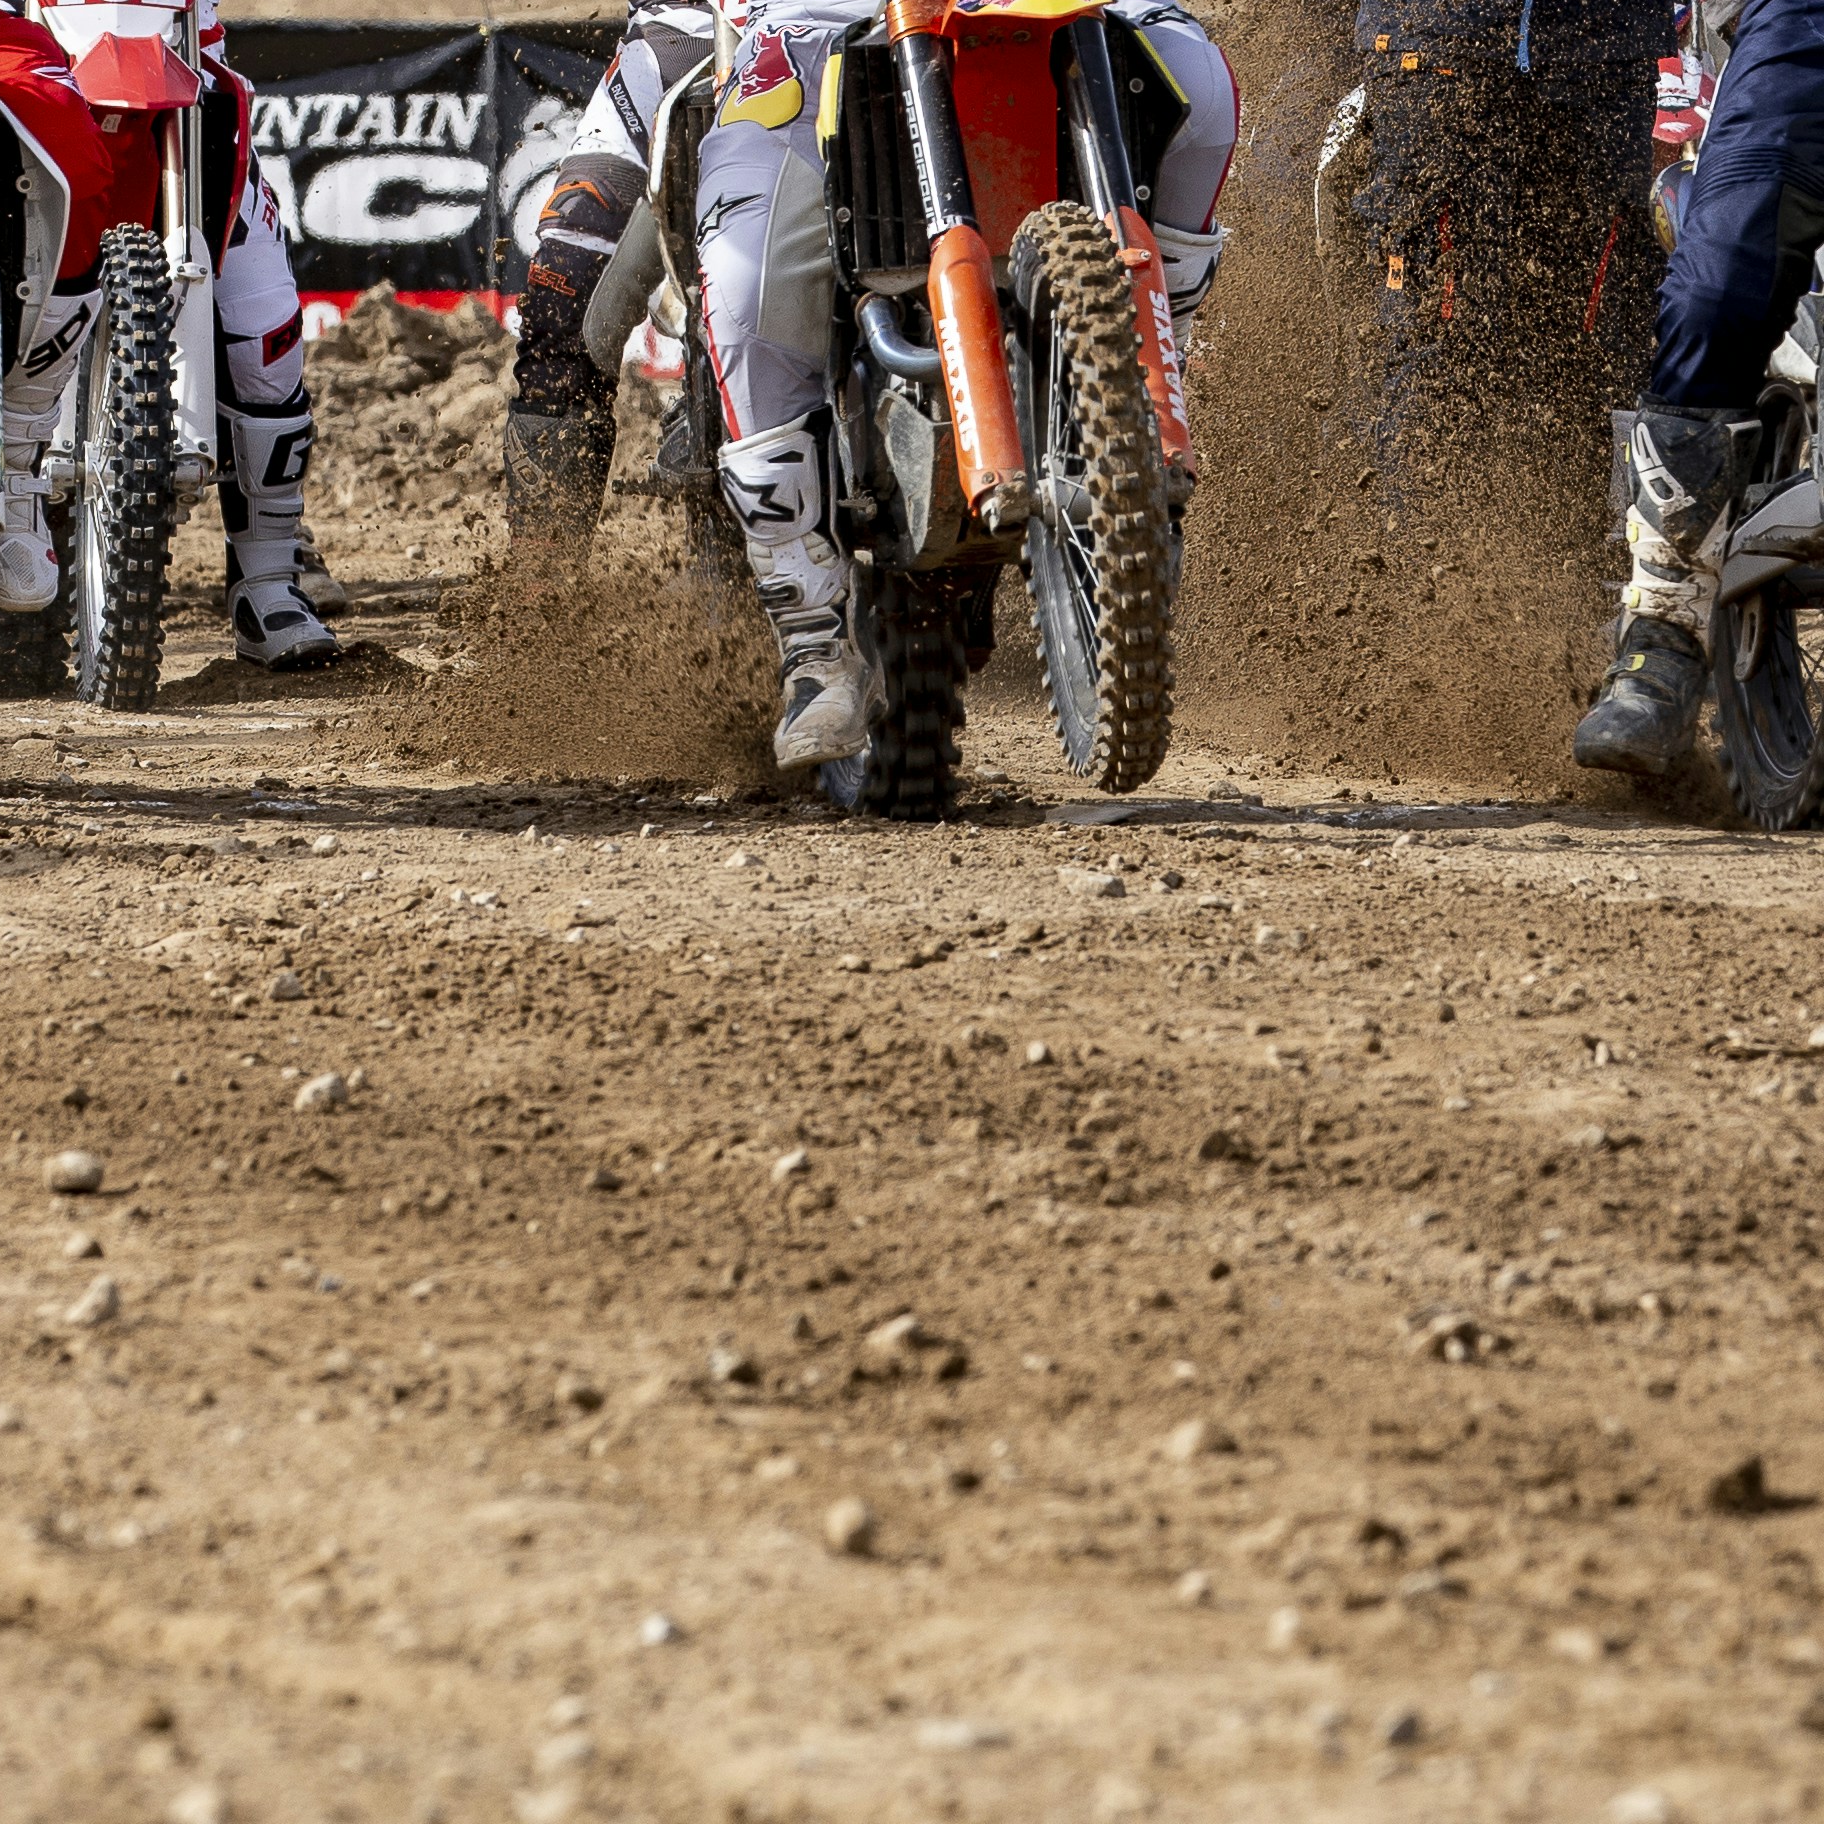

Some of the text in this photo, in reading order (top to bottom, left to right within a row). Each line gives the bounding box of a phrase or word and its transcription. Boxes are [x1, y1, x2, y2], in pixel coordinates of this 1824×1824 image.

[252, 92, 489, 150] NTAIN
[902, 89, 922, 140] PRO
[939, 318, 977, 453] MAXXIS
[1148, 289, 1189, 429] MAXXIS
